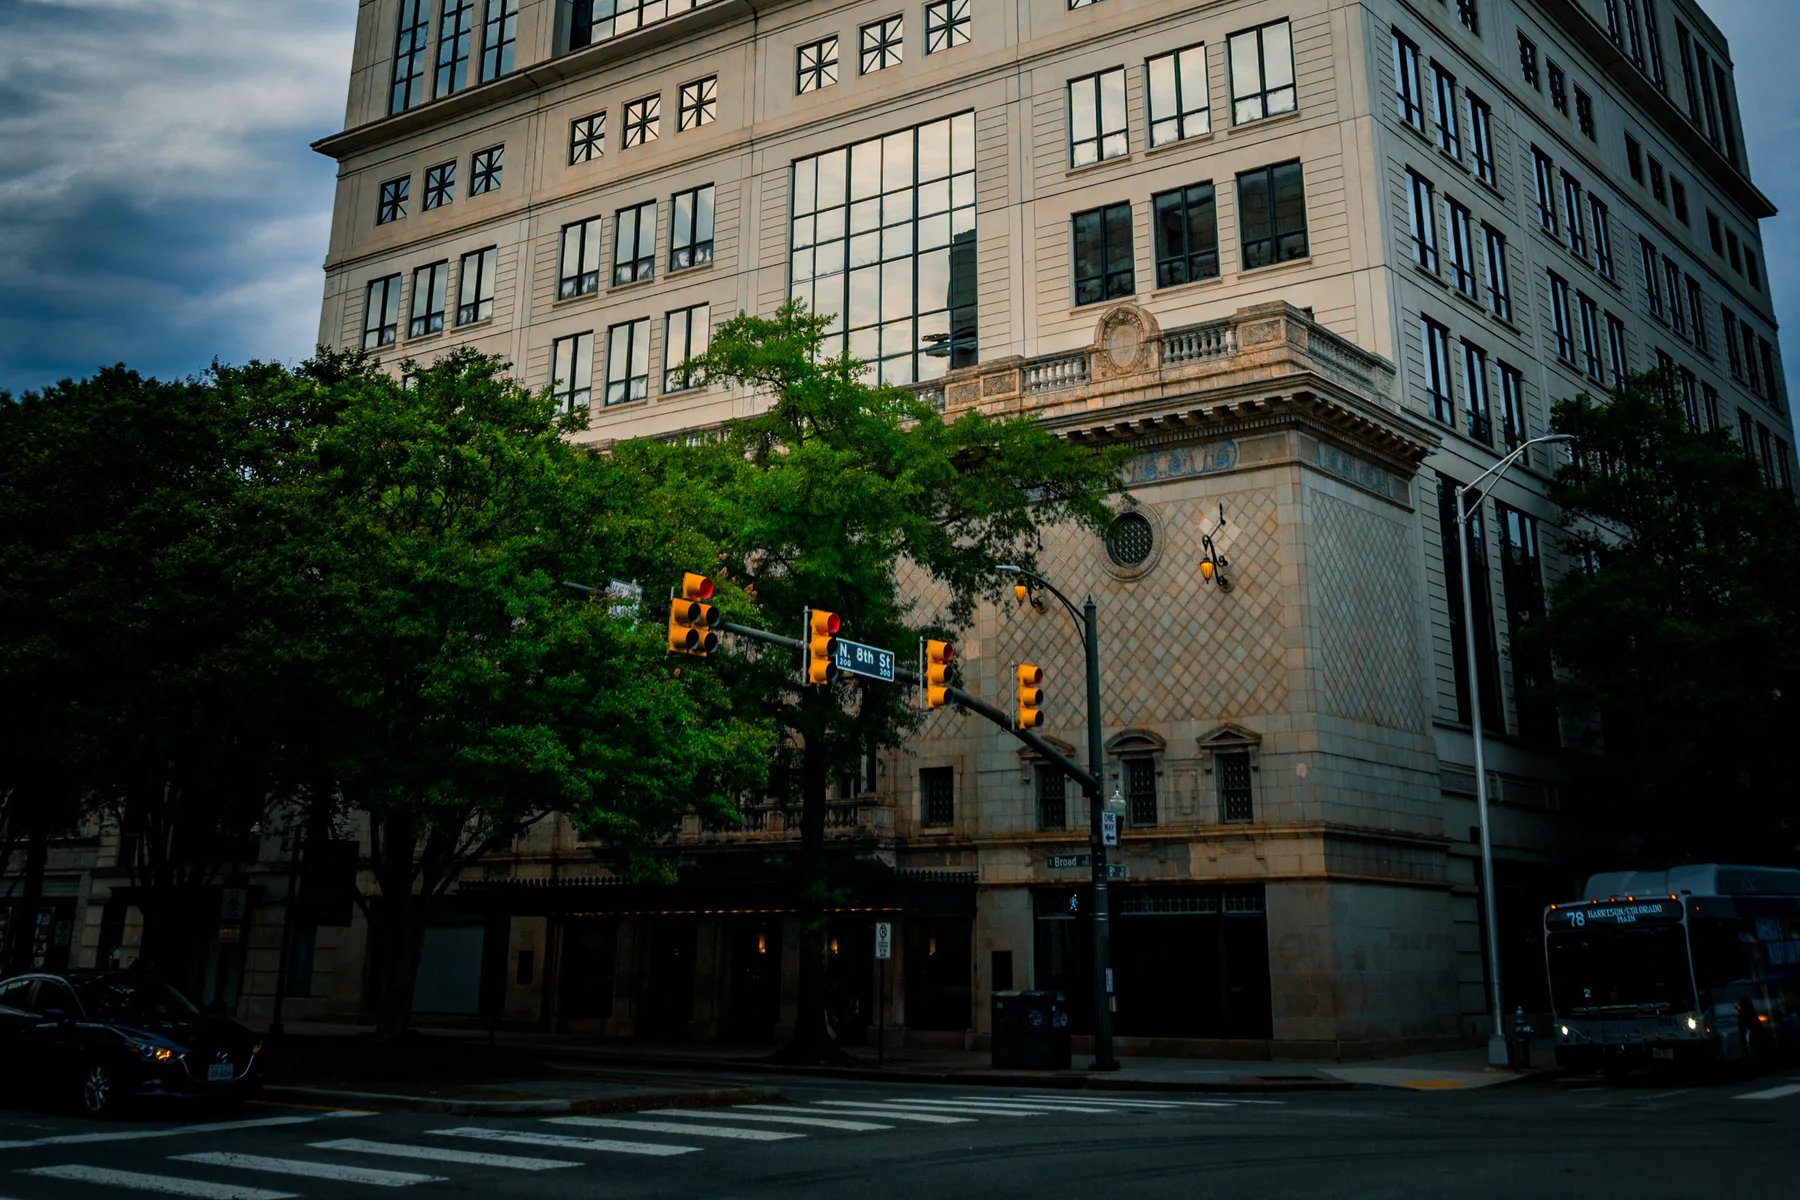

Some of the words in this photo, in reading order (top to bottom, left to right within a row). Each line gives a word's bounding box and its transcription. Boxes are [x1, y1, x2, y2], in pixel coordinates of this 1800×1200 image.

[840, 658, 851, 666] 200
[856, 648, 874, 664] 8th
[880, 654, 890, 668] St
[1104, 814, 1114, 822] ONE
[1104, 824, 1114, 832] WAY
[1054, 856, 1076, 867] Broad
[1566, 911, 1586, 927] 78
[1588, 904, 1662, 918] HARRISON/COLORADO
[1617, 915, 1636, 924] MAIN
[1584, 987, 1592, 998] 2
